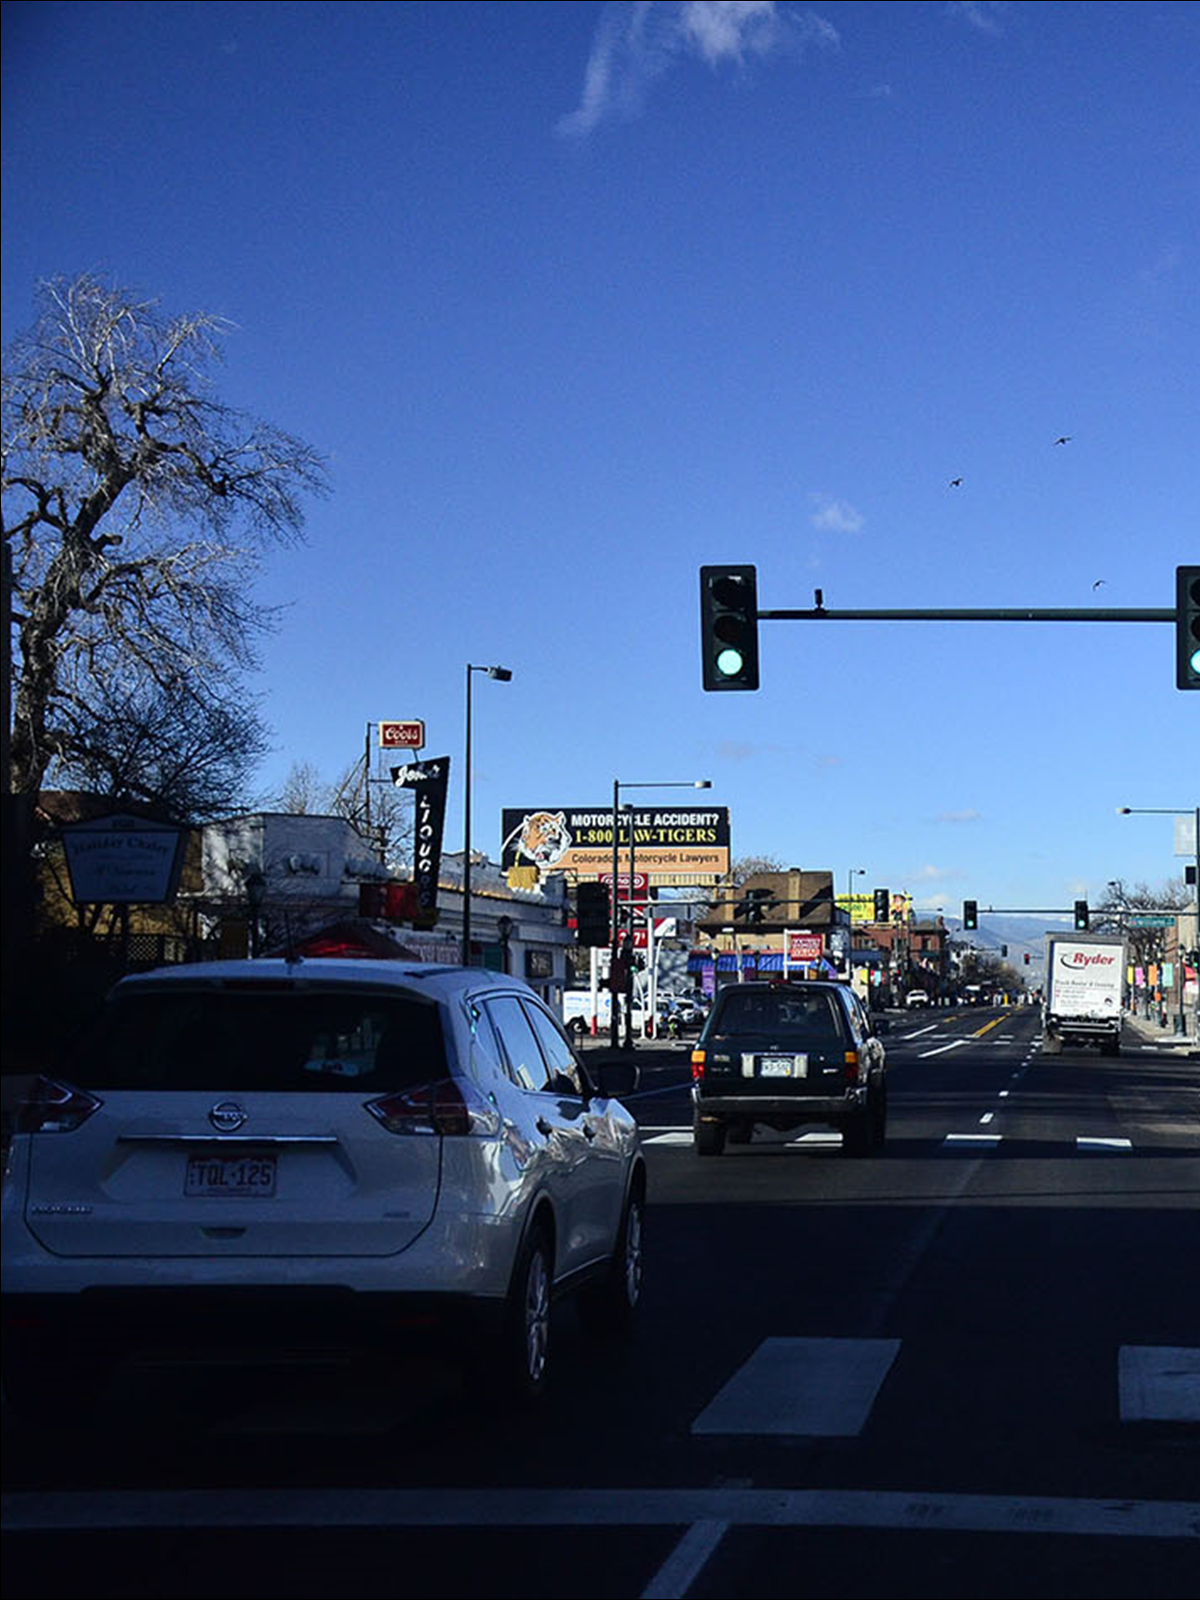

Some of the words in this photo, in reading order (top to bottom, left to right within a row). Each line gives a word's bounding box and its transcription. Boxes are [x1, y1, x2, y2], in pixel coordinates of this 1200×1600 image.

[653, 813, 719, 827] ACCIDENT?
[572, 853, 623, 865] Colorados
[679, 852, 719, 865] Lawyers
[1073, 952, 1115, 967] Ryder
